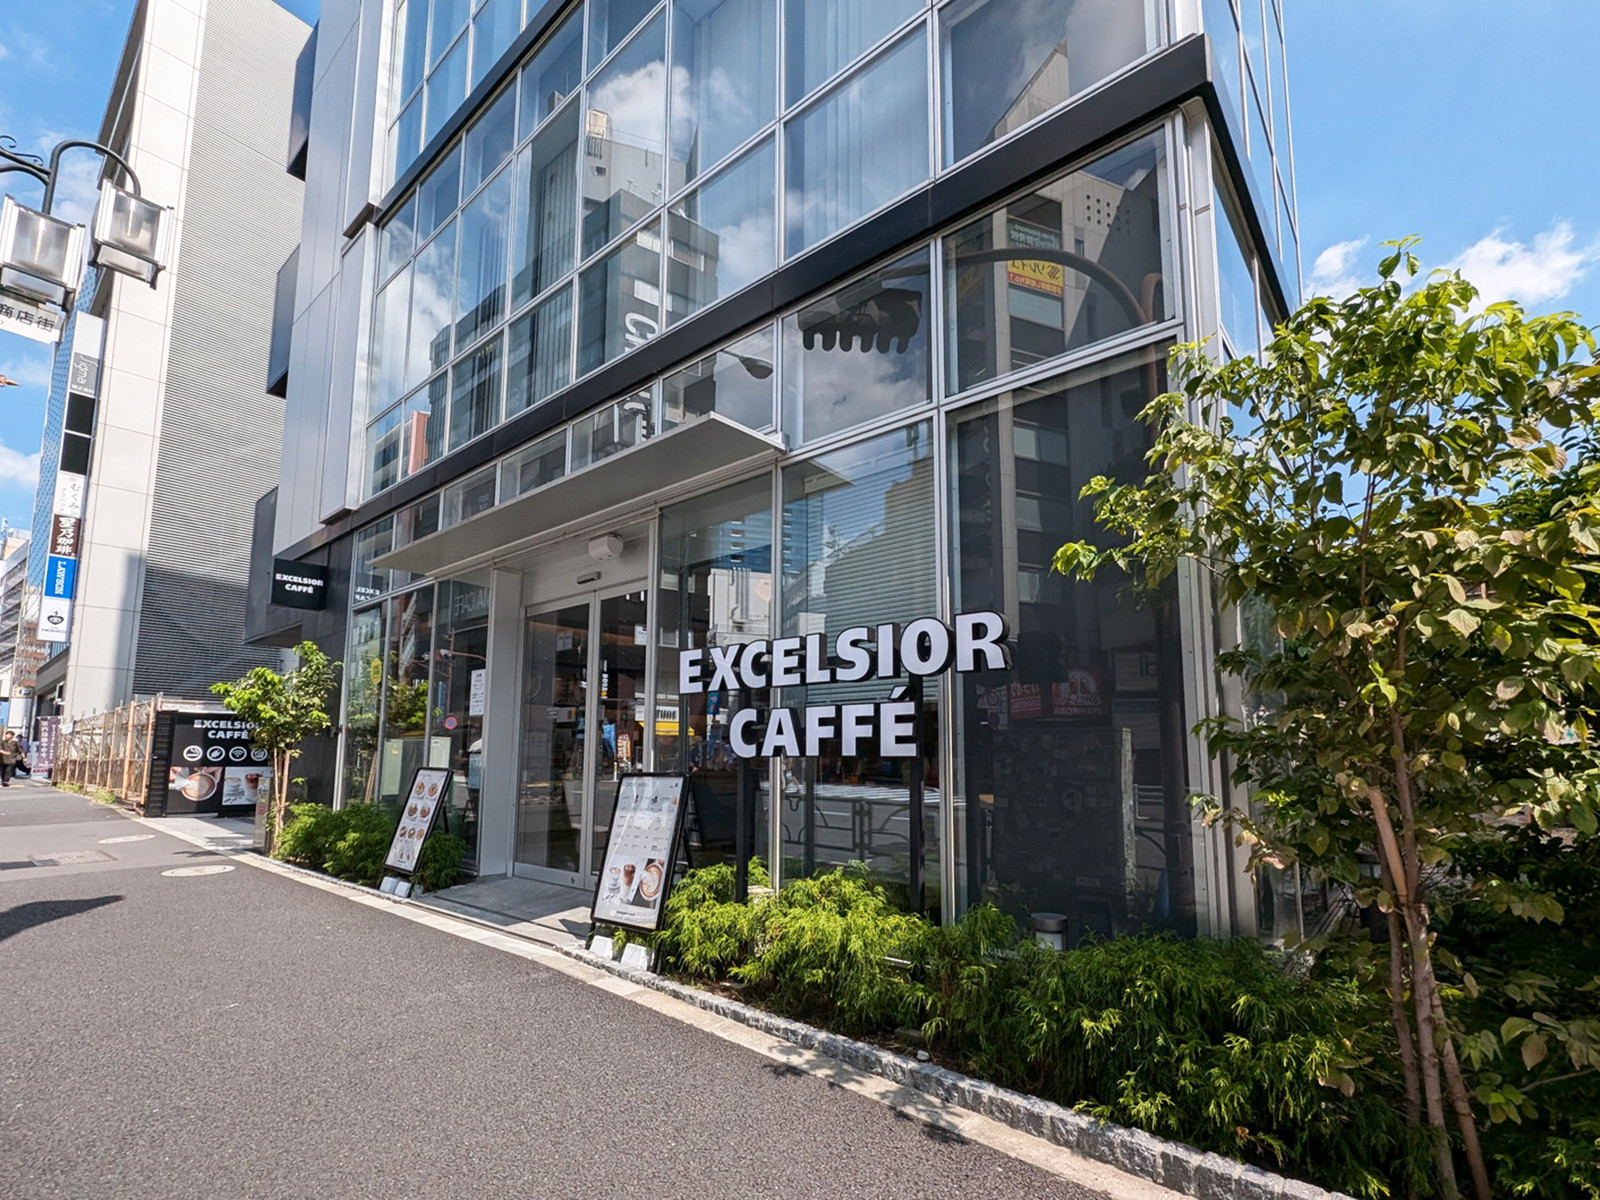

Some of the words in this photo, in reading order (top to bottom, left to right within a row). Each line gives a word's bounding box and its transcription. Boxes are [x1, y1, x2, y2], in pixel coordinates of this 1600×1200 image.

[54, 560, 67, 595] LAWSON
[275, 573, 324, 587] EXCELSIOR
[284, 583, 315, 595] CAFFÉ
[679, 610, 1010, 695] EXCELSIOR
[193, 719, 260, 730] EXCELSIO
[729, 685, 918, 759] CAFFÉ
[207, 730, 249, 740] CAFFÉ
